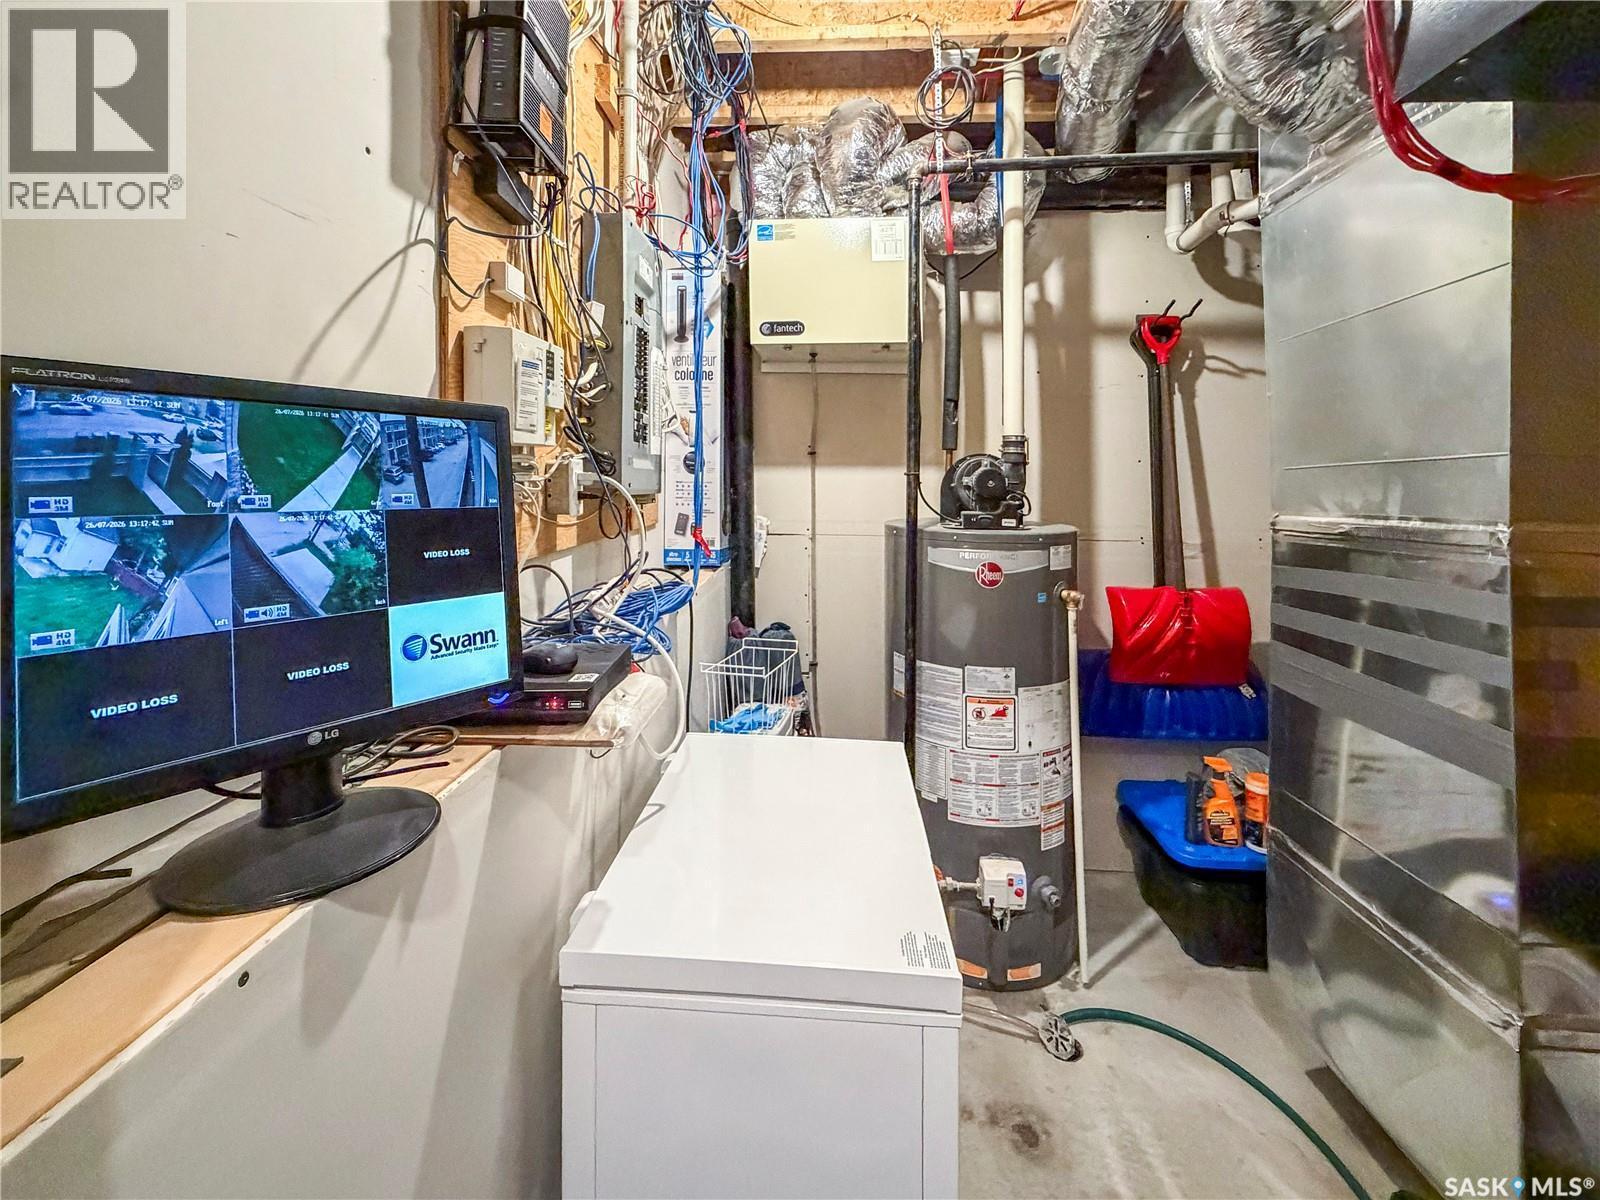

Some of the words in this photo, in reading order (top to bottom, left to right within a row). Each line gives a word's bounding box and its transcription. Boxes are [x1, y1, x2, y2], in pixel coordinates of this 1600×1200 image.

[773, 322, 804, 333] fantech
[671, 355, 718, 367] ventieur
[11, 366, 96, 381] FLATRON
[674, 370, 714, 381] colone
[85, 520, 126, 529] 26/07/2026
[129, 519, 160, 527] 13:17:42
[423, 550, 449, 559] VIDEO
[449, 548, 471, 557] LOSS
[979, 561, 1002, 585] Rheem
[56, 631, 72, 639] HD
[55, 637, 72, 646] 4M
[429, 628, 497, 655] Swann
[430, 651, 455, 661] Advanced
[455, 648, 473, 656] Security
[286, 667, 321, 681] VIDEO
[322, 661, 350, 674] LOSS
[89, 701, 138, 719] VIDEO
[141, 693, 179, 710] LOSS
[324, 729, 340, 740] LG
